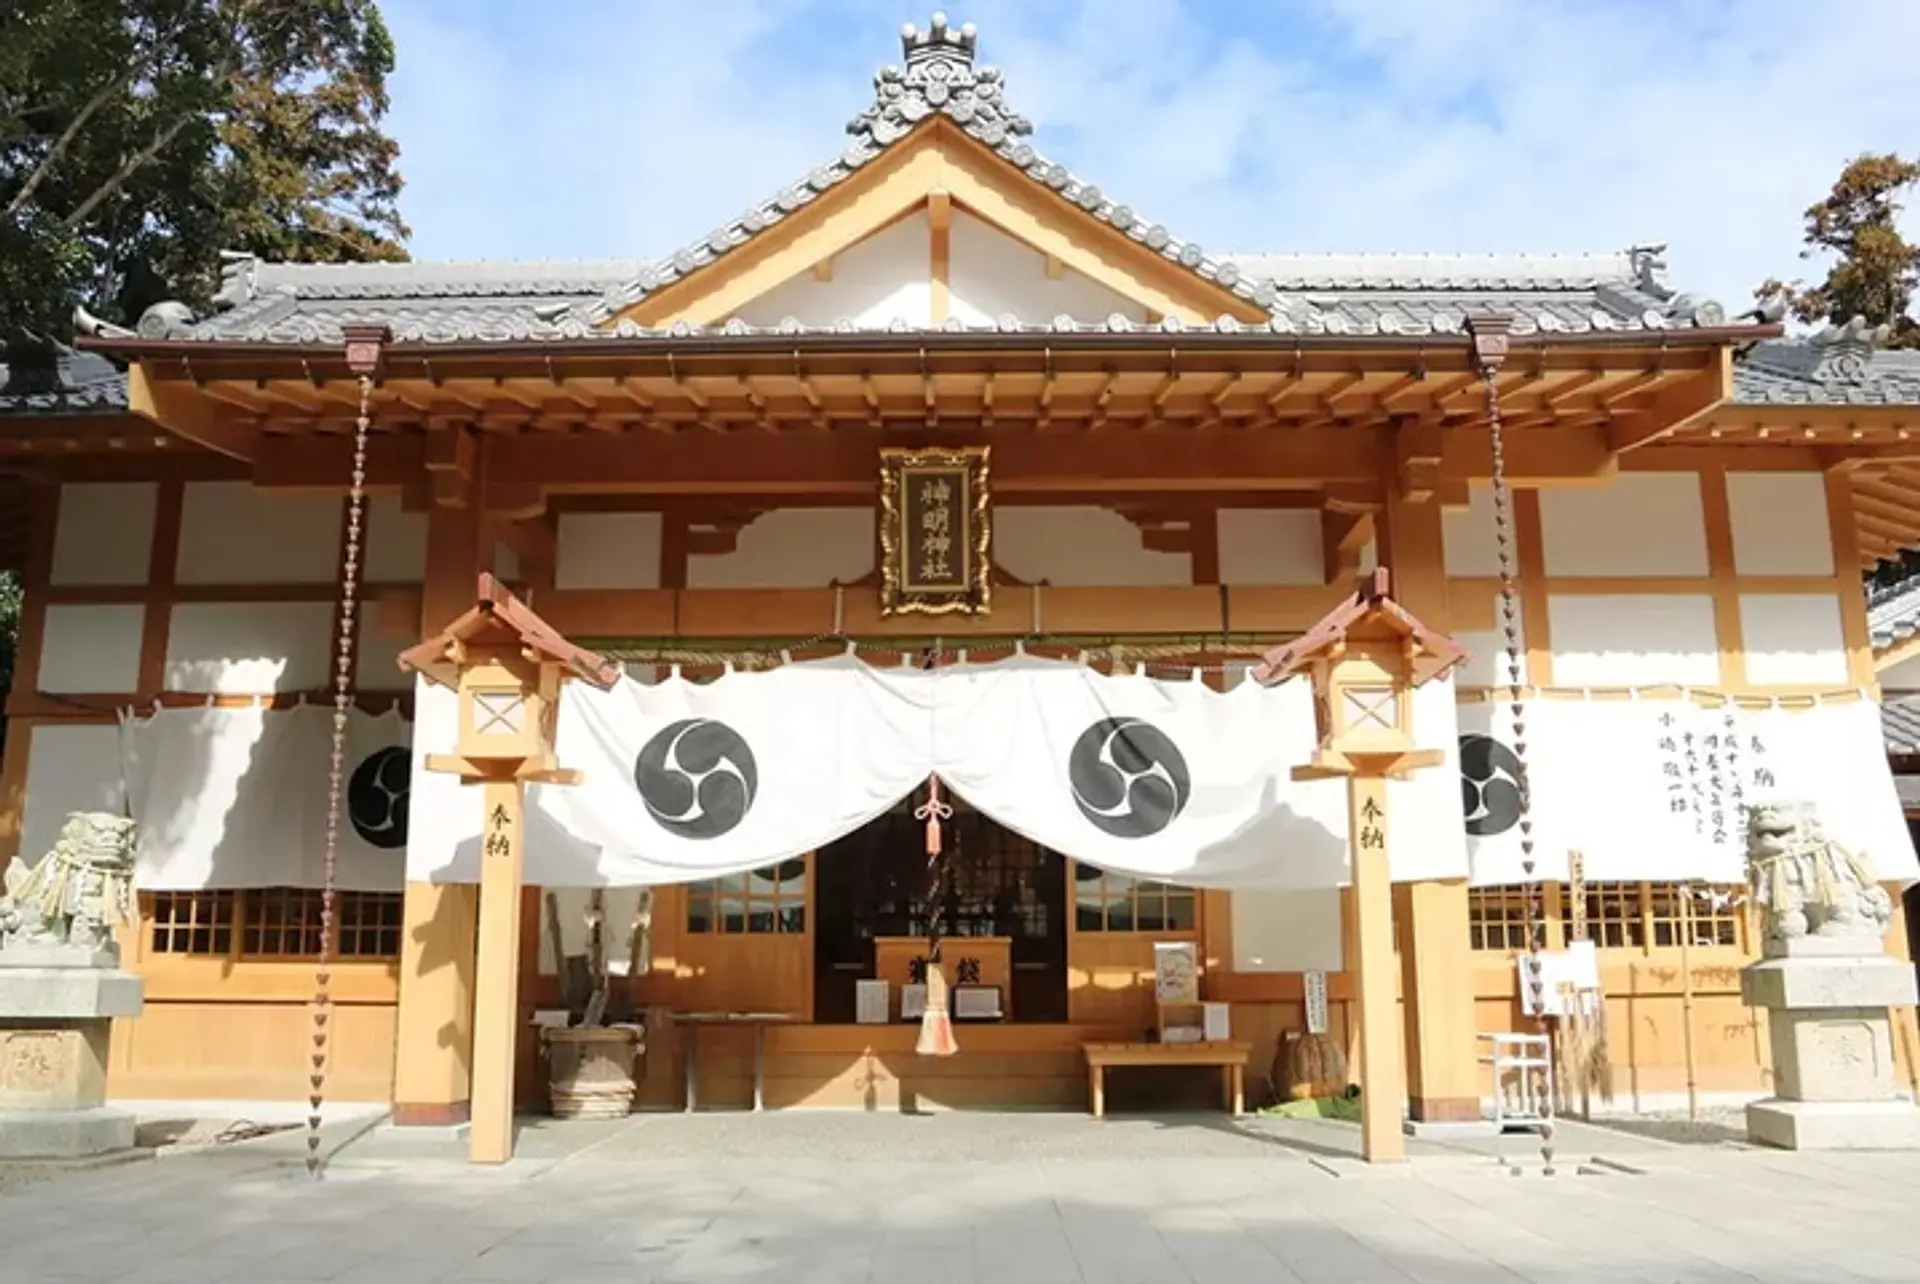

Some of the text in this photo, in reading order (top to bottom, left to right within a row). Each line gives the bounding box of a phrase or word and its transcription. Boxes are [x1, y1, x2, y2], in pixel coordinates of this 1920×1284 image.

[920, 478, 952, 580] 神明神社
[486, 803, 512, 857] 奉納
[1360, 795, 1384, 850] 奉納
